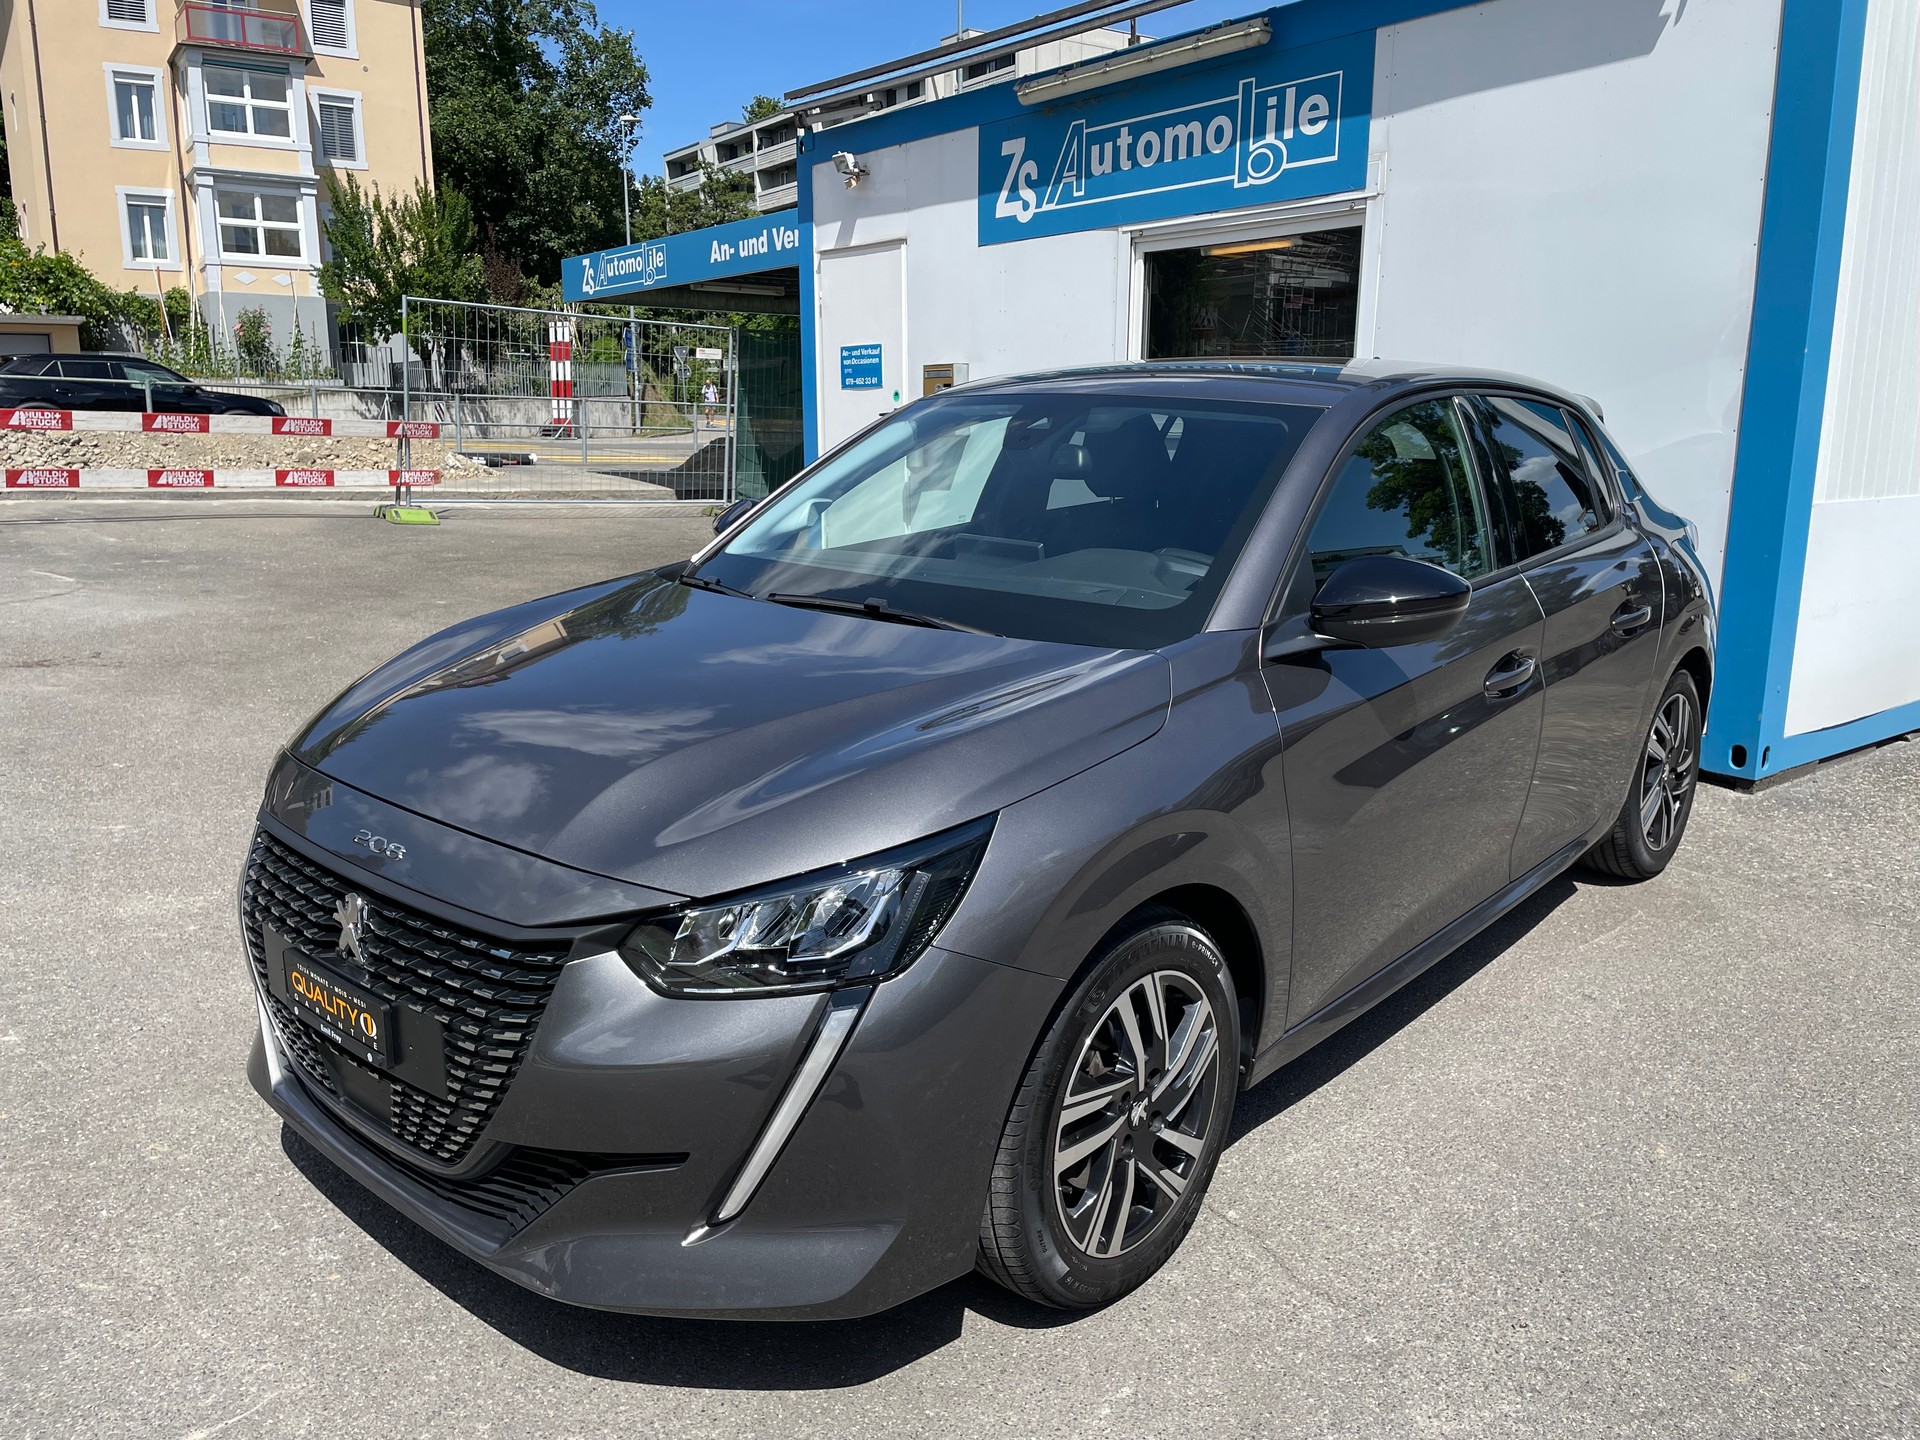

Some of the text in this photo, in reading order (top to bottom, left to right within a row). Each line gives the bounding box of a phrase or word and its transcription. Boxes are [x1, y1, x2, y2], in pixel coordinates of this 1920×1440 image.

[1041, 78, 1331, 211] Automobile
[595, 243, 664, 289] Automobile
[710, 240, 735, 264] An-
[739, 229, 768, 258] und
[861, 347, 880, 355] Verkauf
[352, 829, 406, 861] 208
[291, 971, 359, 1026] QUALITY
